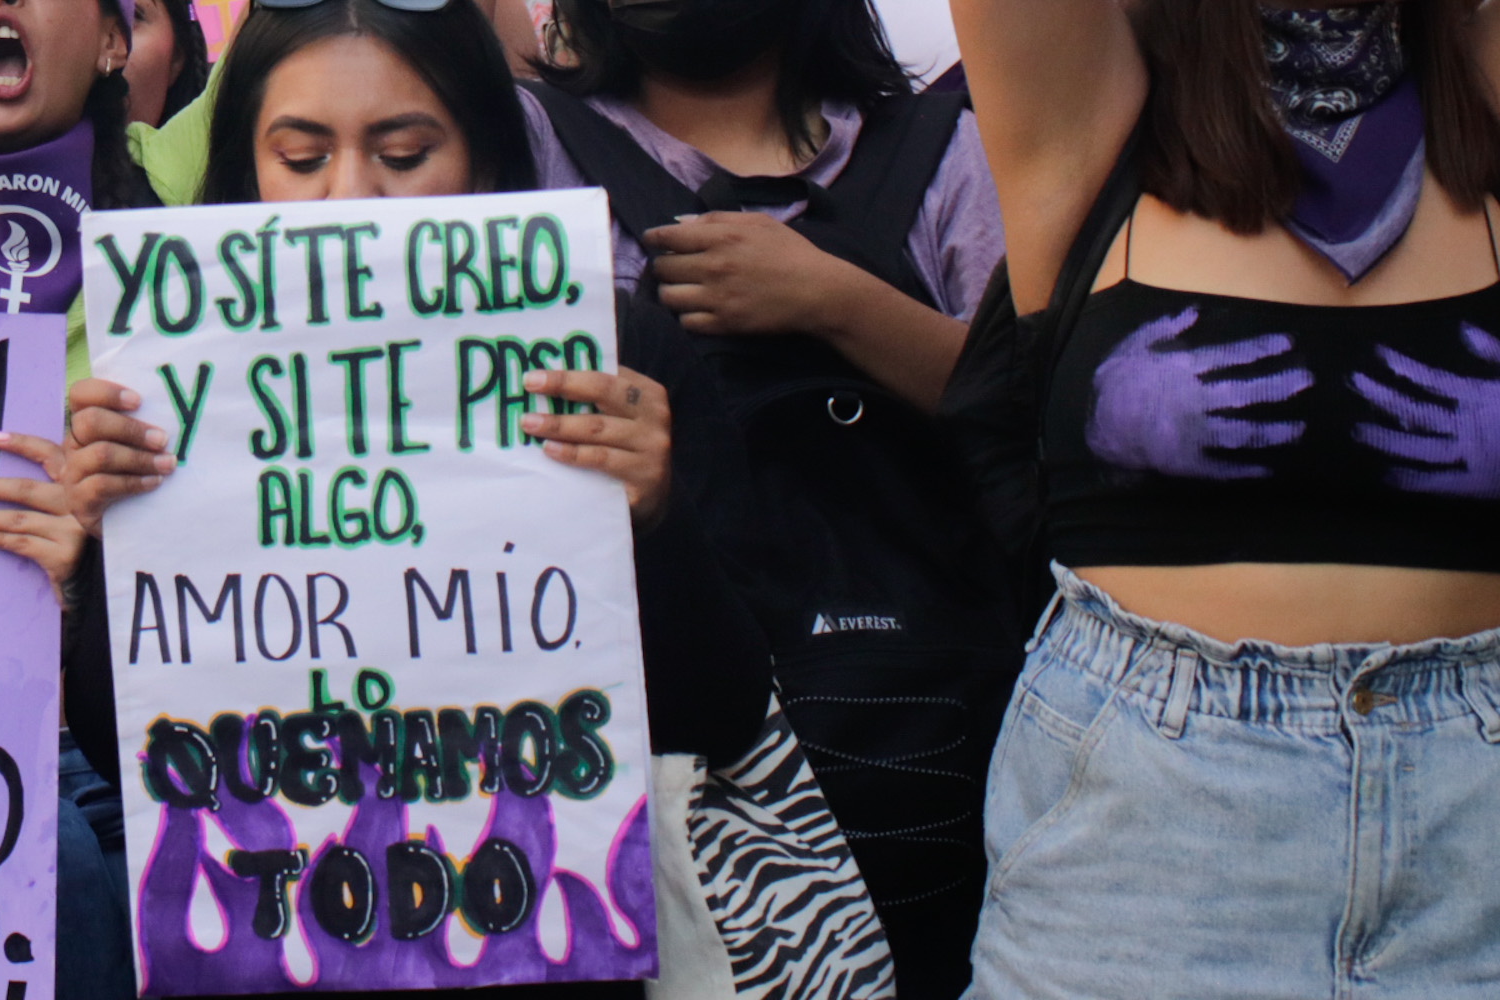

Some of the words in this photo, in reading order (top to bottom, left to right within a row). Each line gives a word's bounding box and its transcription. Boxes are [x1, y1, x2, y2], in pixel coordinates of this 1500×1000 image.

[95, 229, 203, 336] YO
[284, 220, 385, 326] TE
[405, 211, 583, 320] CREO,
[157, 361, 212, 469] Y
[246, 352, 316, 461] SI
[329, 340, 432, 458] TE
[257, 466, 426, 548] ALGO,
[128, 570, 358, 665] AMOR
[838, 615, 897, 631] EVEREST
[309, 668, 394, 714] LO
[141, 688, 616, 812] QUEMAMOS
[225, 836, 537, 943] TODO
